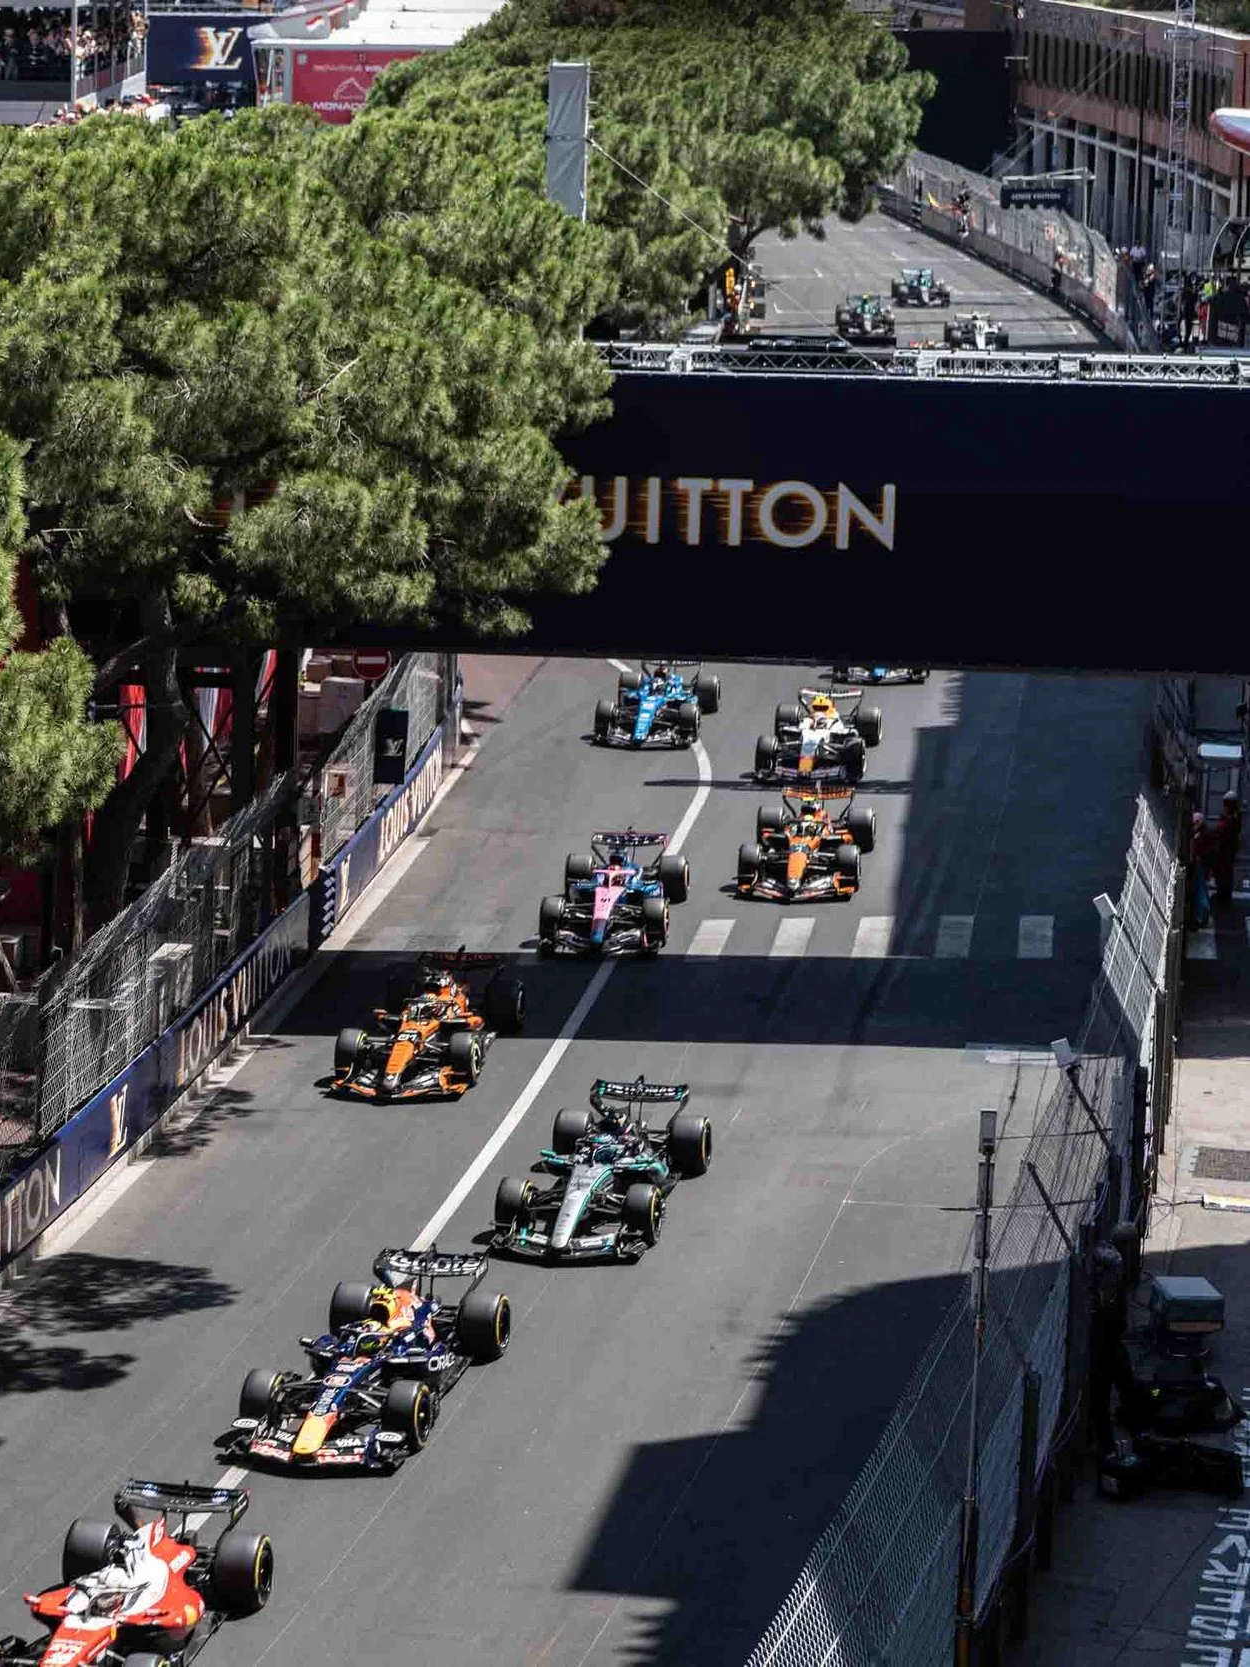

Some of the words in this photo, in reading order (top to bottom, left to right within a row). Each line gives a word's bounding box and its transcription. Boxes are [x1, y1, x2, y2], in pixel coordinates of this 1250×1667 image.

[556, 475, 897, 551] UITTON
[378, 786, 410, 863] LOUIS
[177, 987, 228, 1087] LOUIS
[231, 932, 292, 1026] VUITTON
[275, 1430, 296, 1443] VISA
[335, 1438, 362, 1448] VISA
